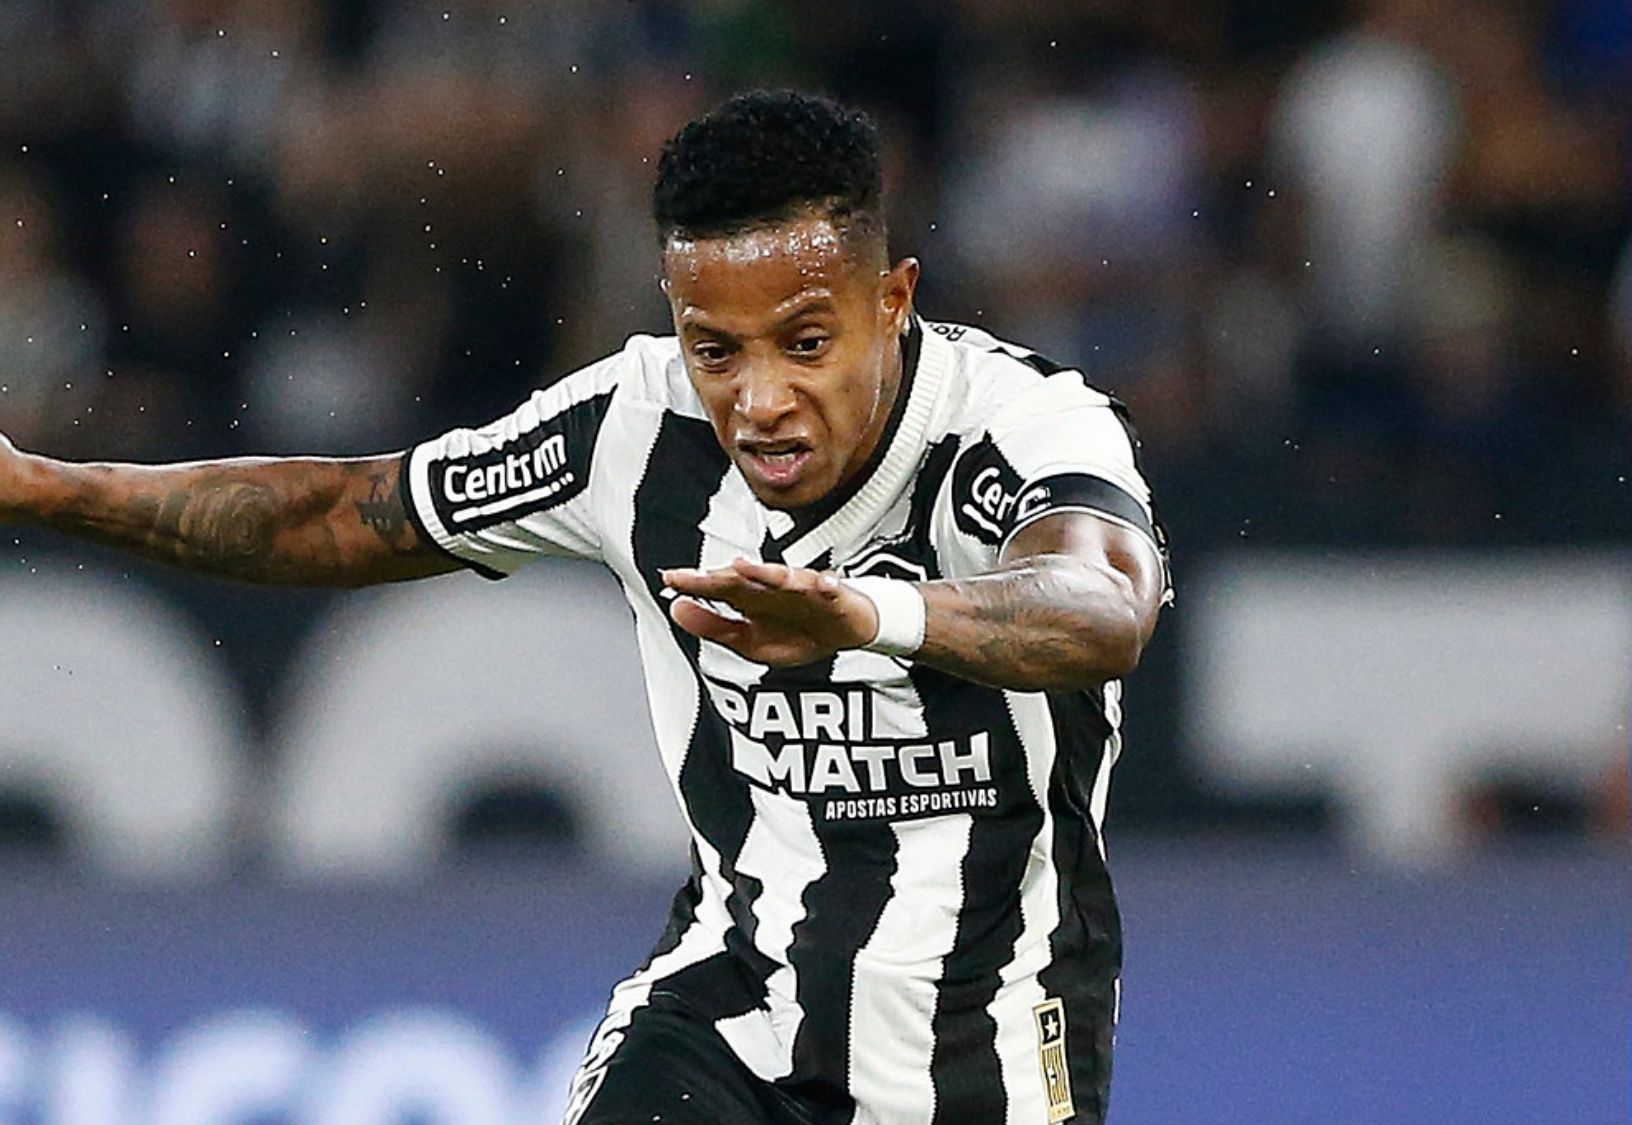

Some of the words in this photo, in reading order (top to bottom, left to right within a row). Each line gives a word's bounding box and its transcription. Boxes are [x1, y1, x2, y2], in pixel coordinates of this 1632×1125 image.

[729, 731, 991, 793] MATCH
[825, 797, 897, 820] APOSTAS
[900, 789, 998, 814] ESPORTIVAS
